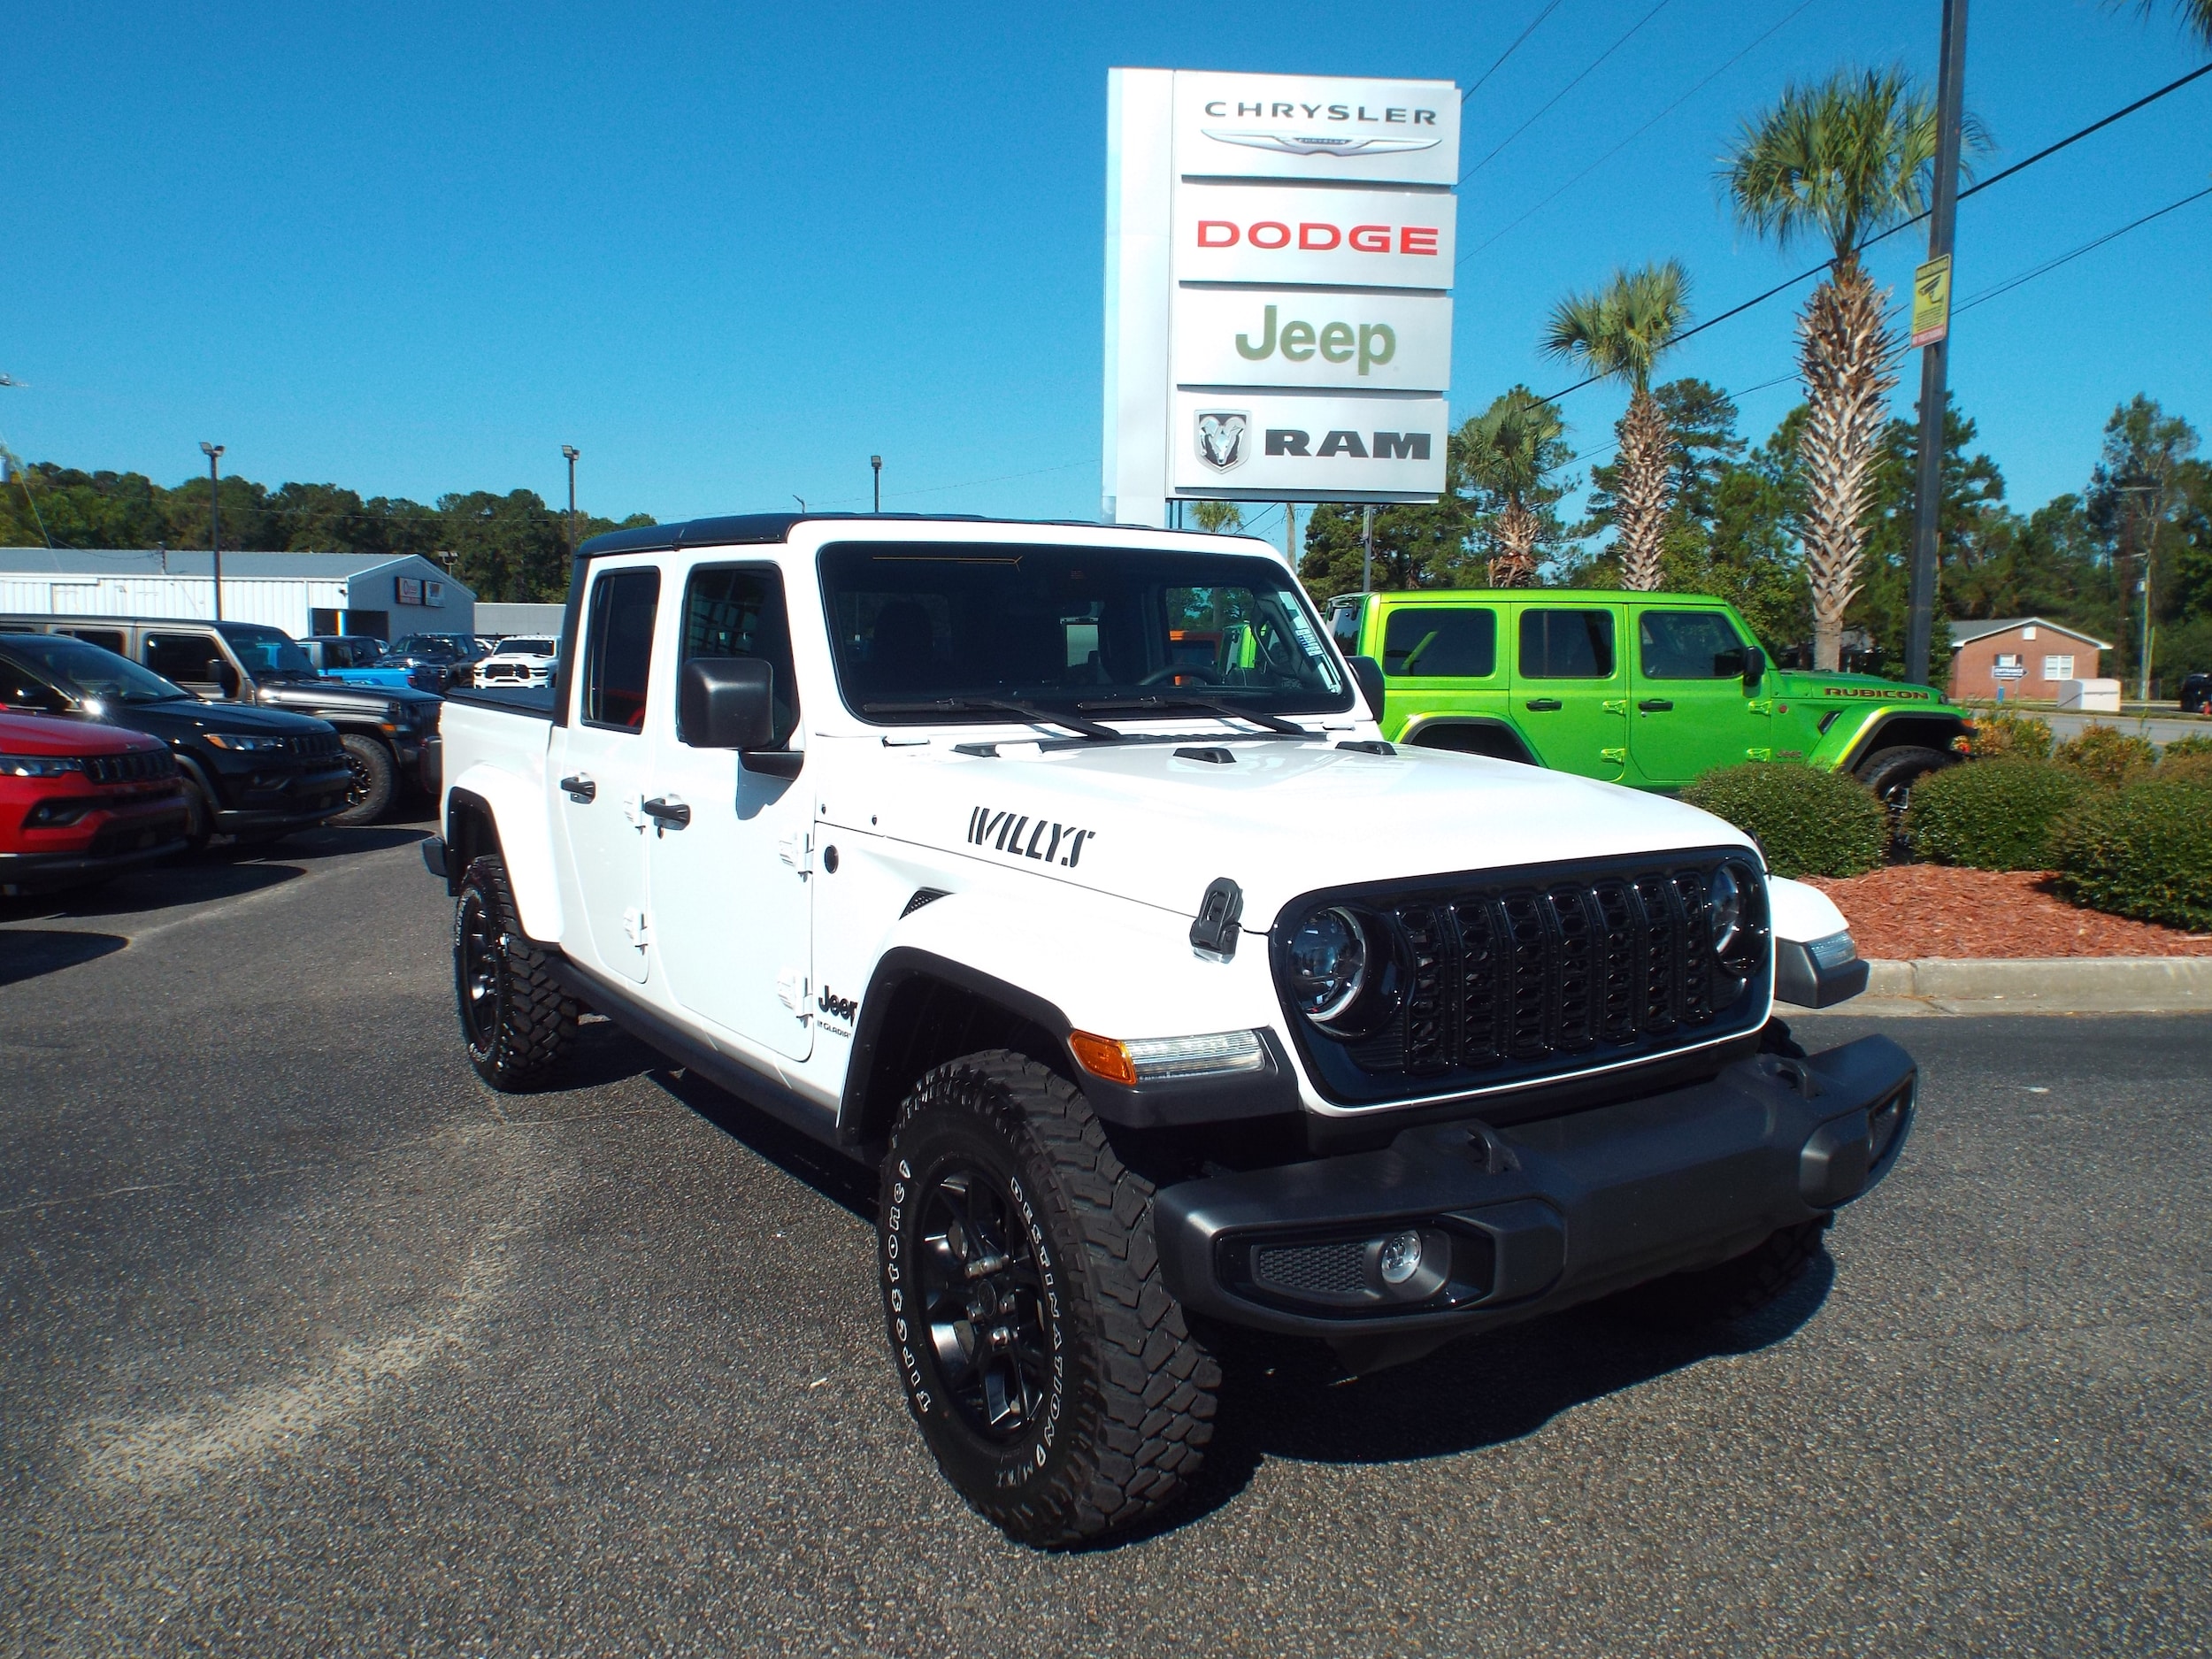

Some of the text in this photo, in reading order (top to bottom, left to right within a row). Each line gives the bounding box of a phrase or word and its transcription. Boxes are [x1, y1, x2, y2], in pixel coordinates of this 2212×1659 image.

[1204, 102, 1437, 126] CHRYSLER
[1197, 219, 1440, 256] DODGE
[1235, 304, 1397, 376] Jeep
[1264, 428, 1432, 461] RAM
[1824, 687, 1930, 700] RUBICON
[967, 806, 1096, 868] WILLYS
[1010, 1176, 1063, 1448] DESTINATION
